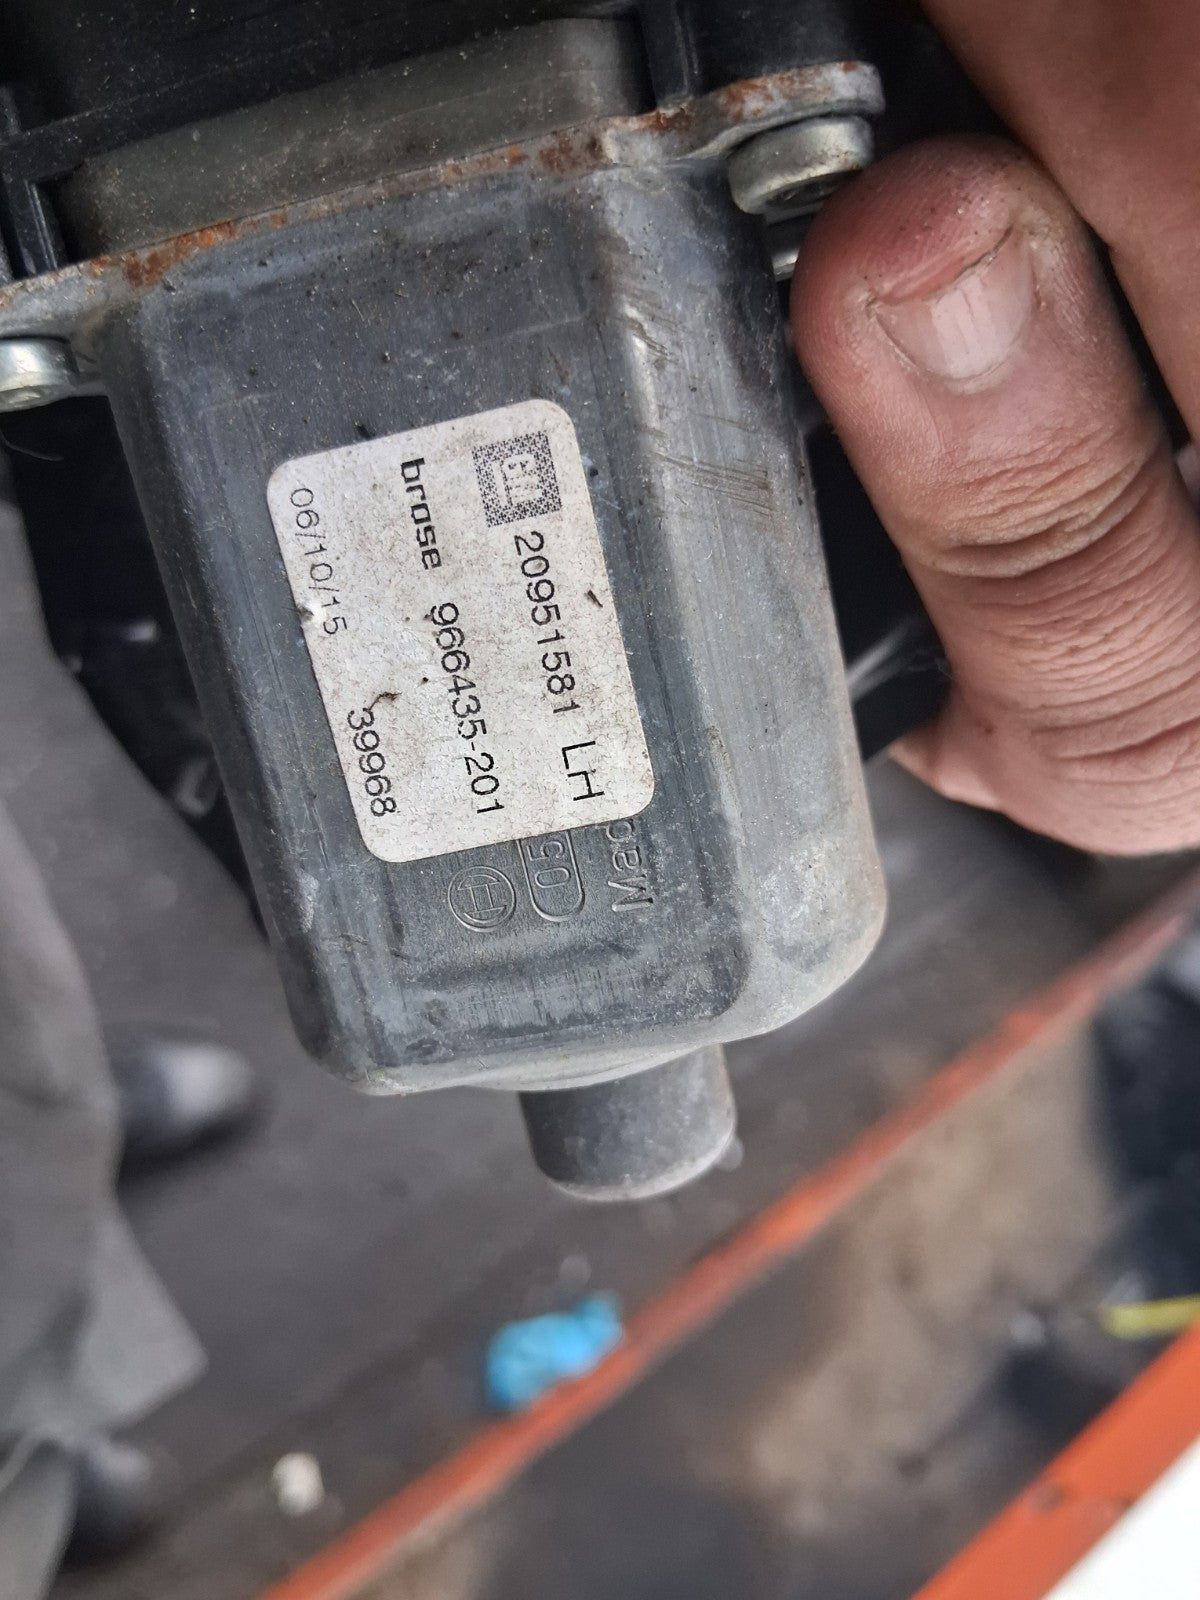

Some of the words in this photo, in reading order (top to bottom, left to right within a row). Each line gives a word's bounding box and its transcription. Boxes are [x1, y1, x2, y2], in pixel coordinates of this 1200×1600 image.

[290, 487, 347, 635] 06/10/15
[347, 707, 397, 817] 39968
[400, 457, 442, 570] brose
[430, 602, 505, 814] 966435-201
[514, 530, 581, 714] 20951581
[561, 740, 605, 801] LH
